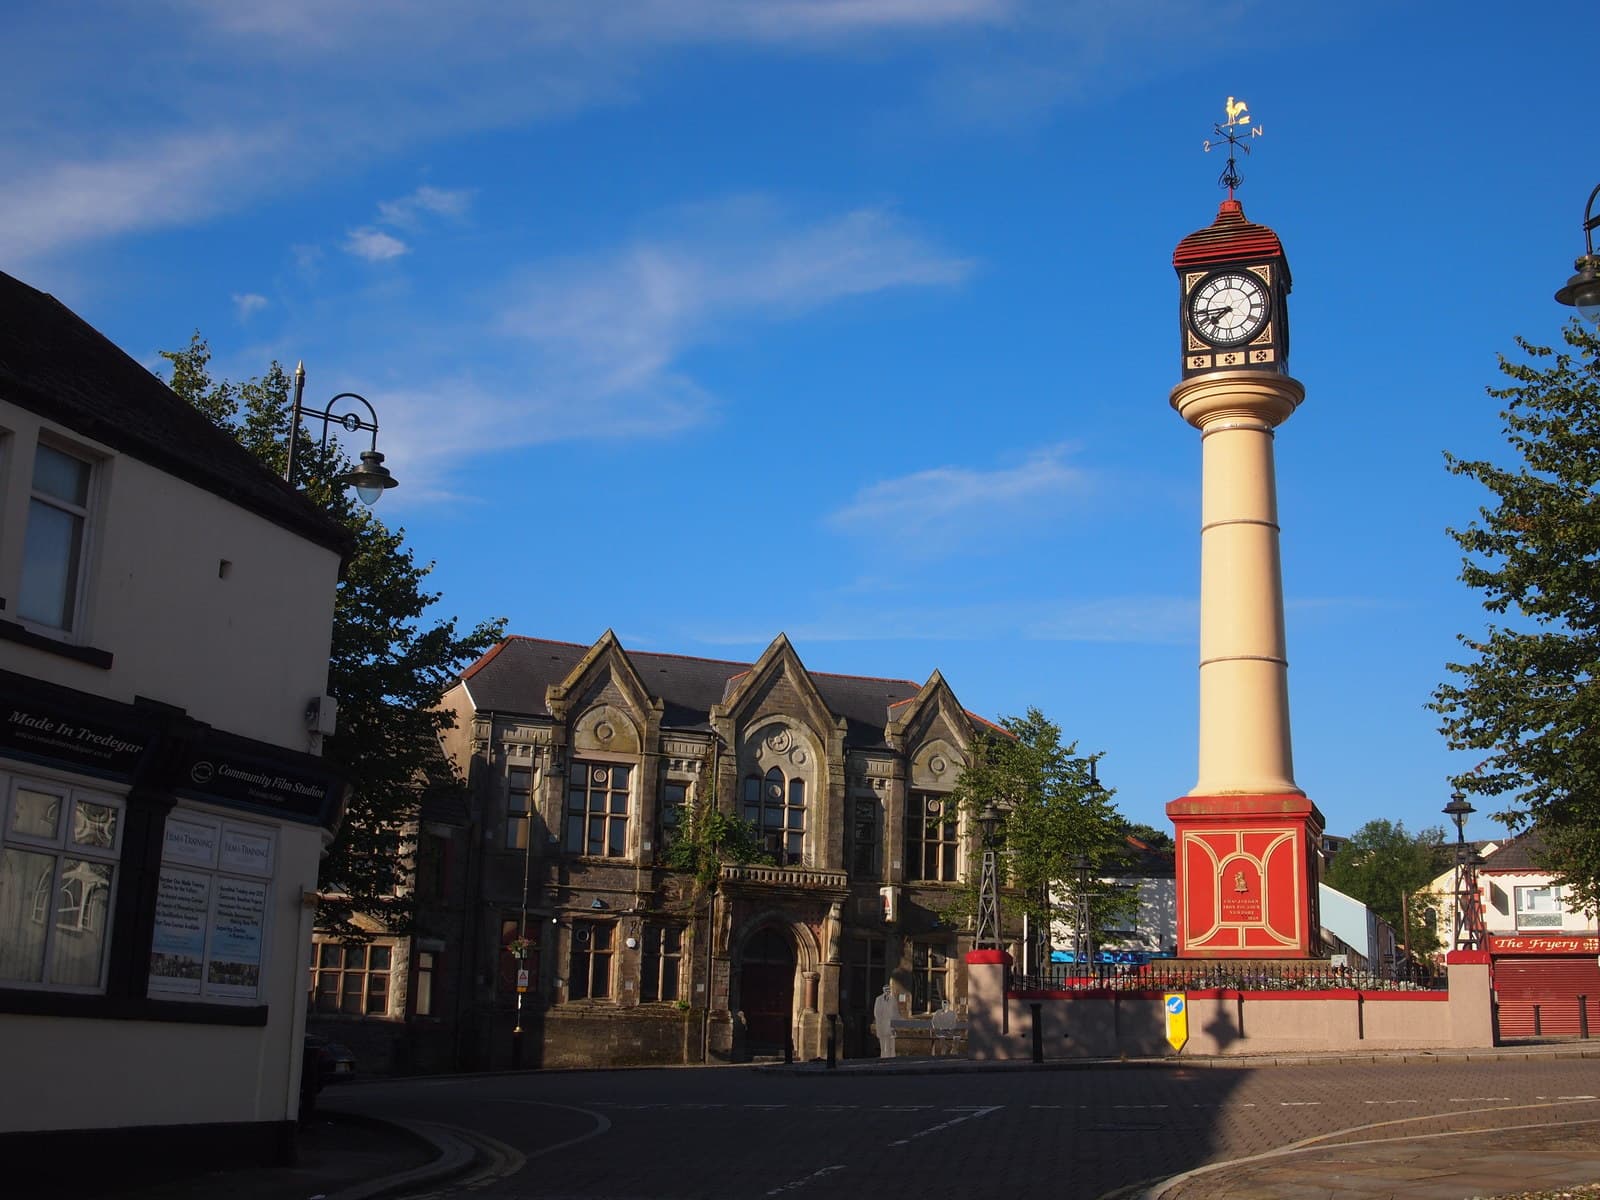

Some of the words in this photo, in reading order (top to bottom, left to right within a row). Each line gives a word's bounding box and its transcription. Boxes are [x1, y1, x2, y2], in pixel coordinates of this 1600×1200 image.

[1252, 125, 1262, 138] N
[8, 710, 54, 731] Made
[55, 722, 74, 737] In
[74, 727, 144, 753] Tredegar
[218, 764, 272, 788] Community
[272, 777, 293, 791] Film
[292, 782, 325, 799] Studios
[1495, 938, 1523, 948] The
[1528, 938, 1579, 951] Fryery
